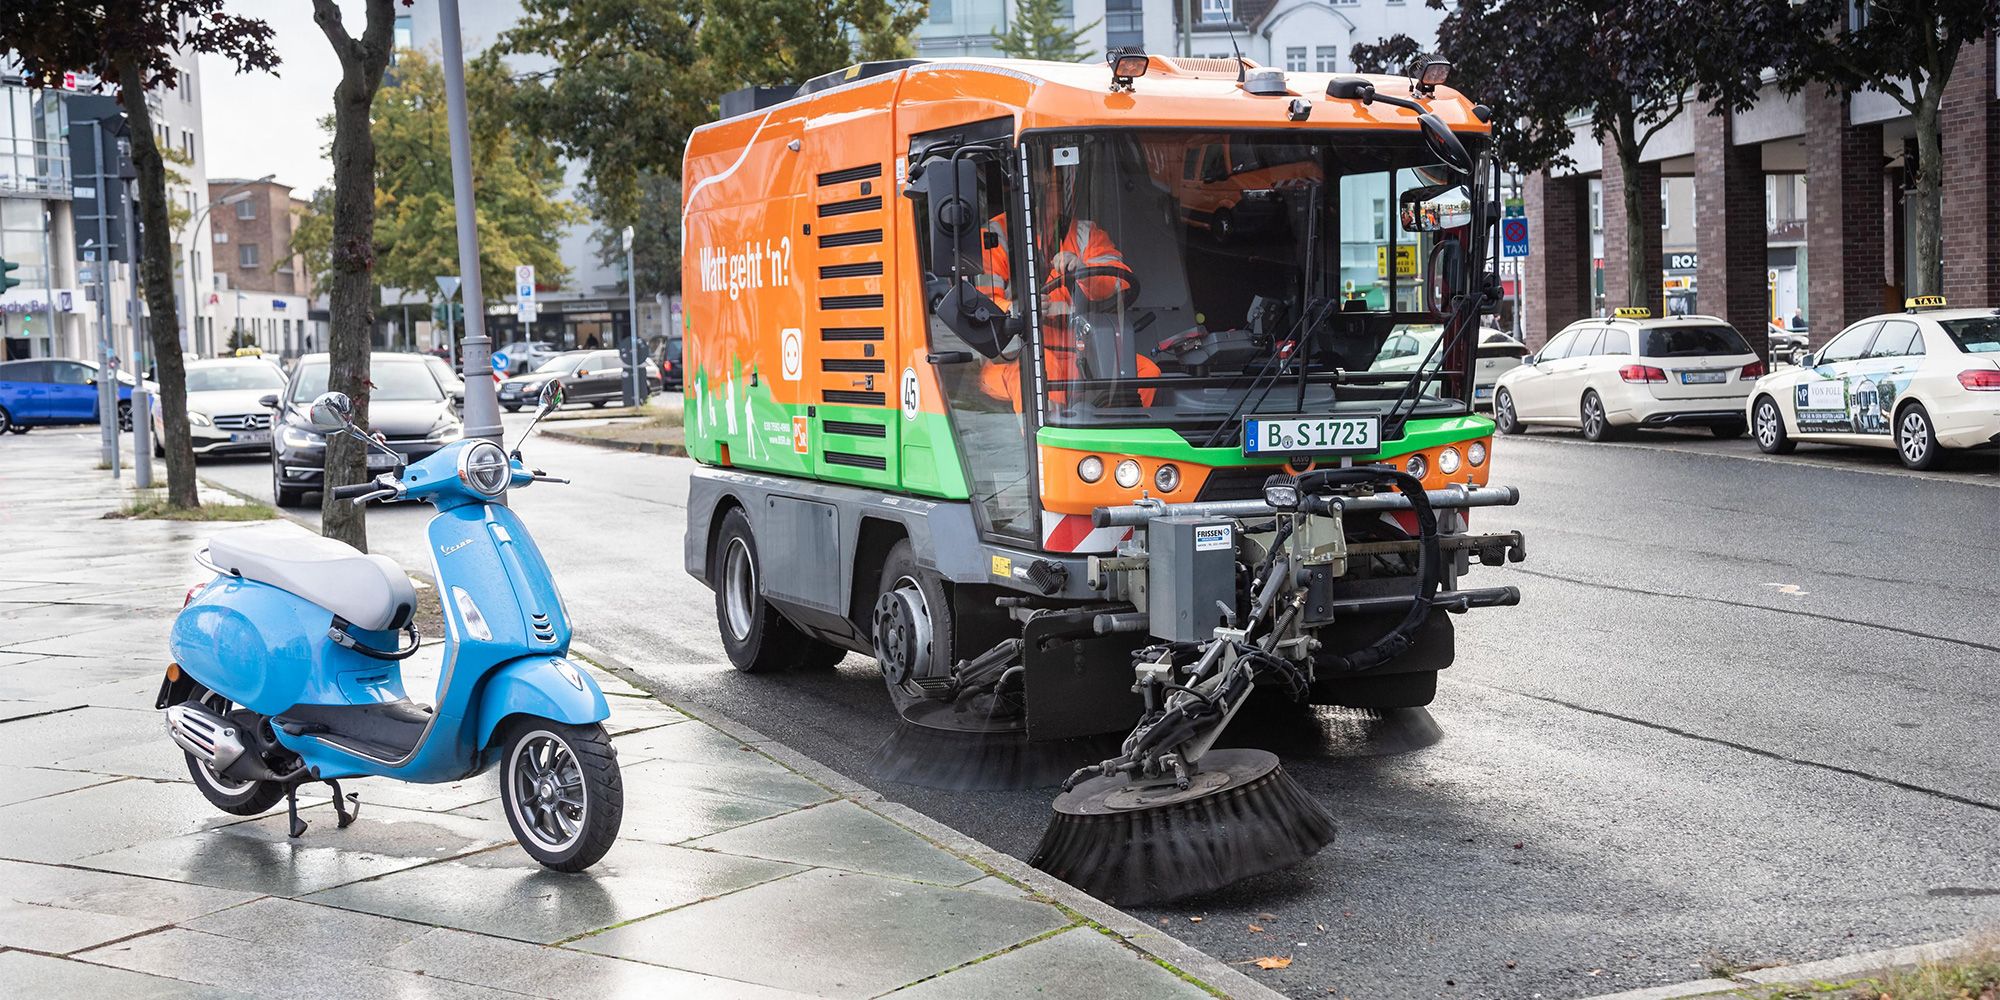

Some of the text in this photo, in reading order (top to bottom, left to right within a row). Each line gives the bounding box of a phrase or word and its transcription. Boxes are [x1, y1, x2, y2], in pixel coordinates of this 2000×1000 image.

[1506, 245, 1527, 254] TAXI
[700, 246, 727, 292] Watt
[730, 241, 763, 301] geht
[1621, 307, 1649, 315] TAXI
[905, 378, 916, 410] 45
[1811, 386, 1841, 395] VON POLL
[1268, 423, 1282, 447] B
[440, 539, 474, 556] Vespa
